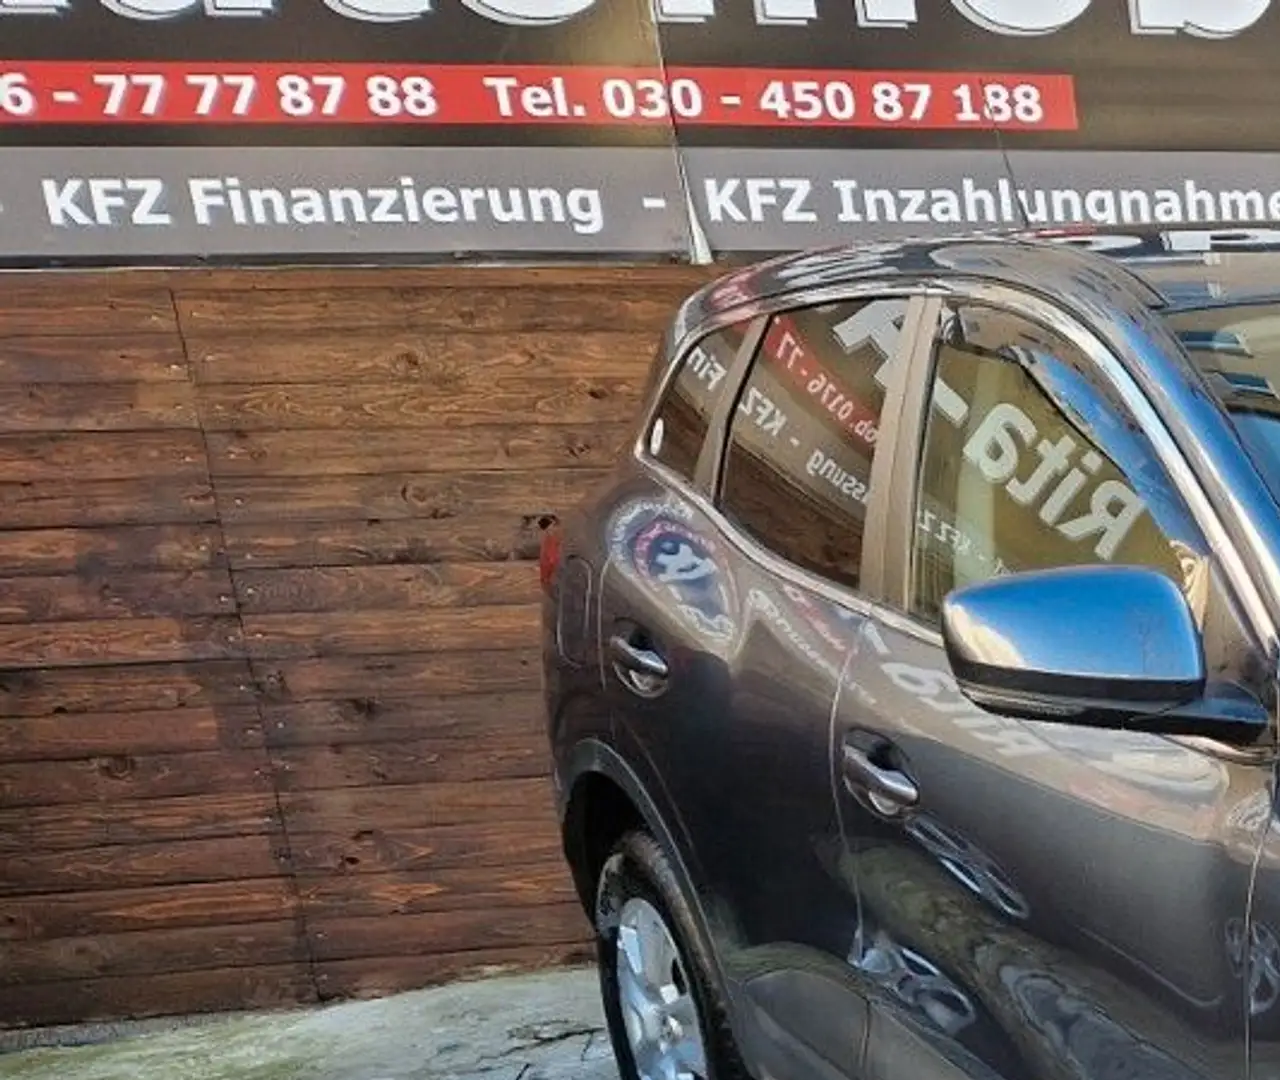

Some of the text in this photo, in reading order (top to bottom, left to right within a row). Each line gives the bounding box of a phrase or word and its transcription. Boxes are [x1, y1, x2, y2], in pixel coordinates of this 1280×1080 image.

[93, 74, 164, 116] 77
[186, 75, 257, 116] 77
[278, 76, 344, 117] 87
[367, 76, 438, 117] 88
[483, 76, 586, 118] Tel.
[602, 78, 702, 119] 030
[759, 80, 856, 121] 450
[871, 82, 931, 121] 87
[953, 84, 1042, 123] 188
[41, 177, 171, 226] KFZ
[188, 177, 601, 234] Finanzierung
[703, 177, 819, 223] KFZ
